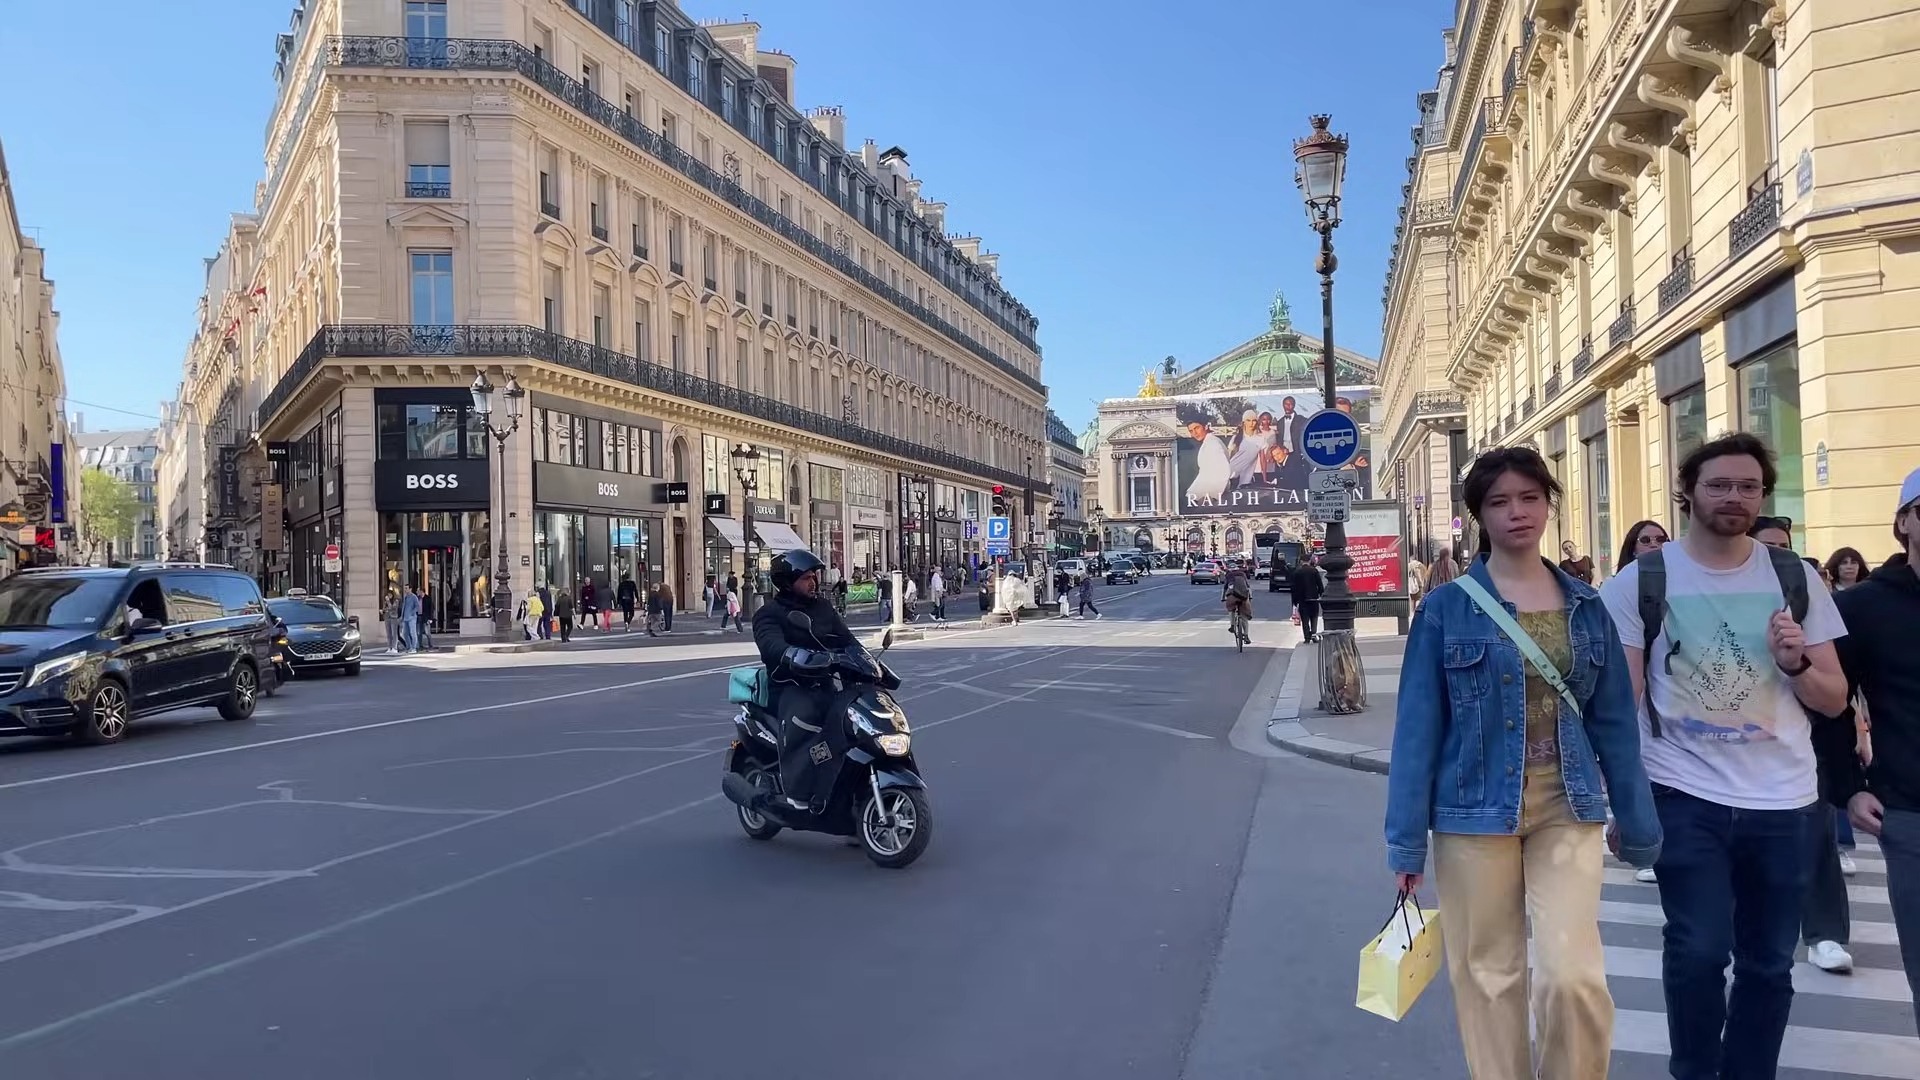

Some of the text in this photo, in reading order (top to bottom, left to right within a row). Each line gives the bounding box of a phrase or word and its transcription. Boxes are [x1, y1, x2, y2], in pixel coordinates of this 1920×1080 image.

[224, 452, 236, 506] HOTEL
[406, 474, 459, 489] BOSS
[598, 482, 619, 497] BOSS
[1187, 490, 1260, 507] RALPH
[994, 521, 1004, 535] P
[593, 564, 605, 572] BOSS
